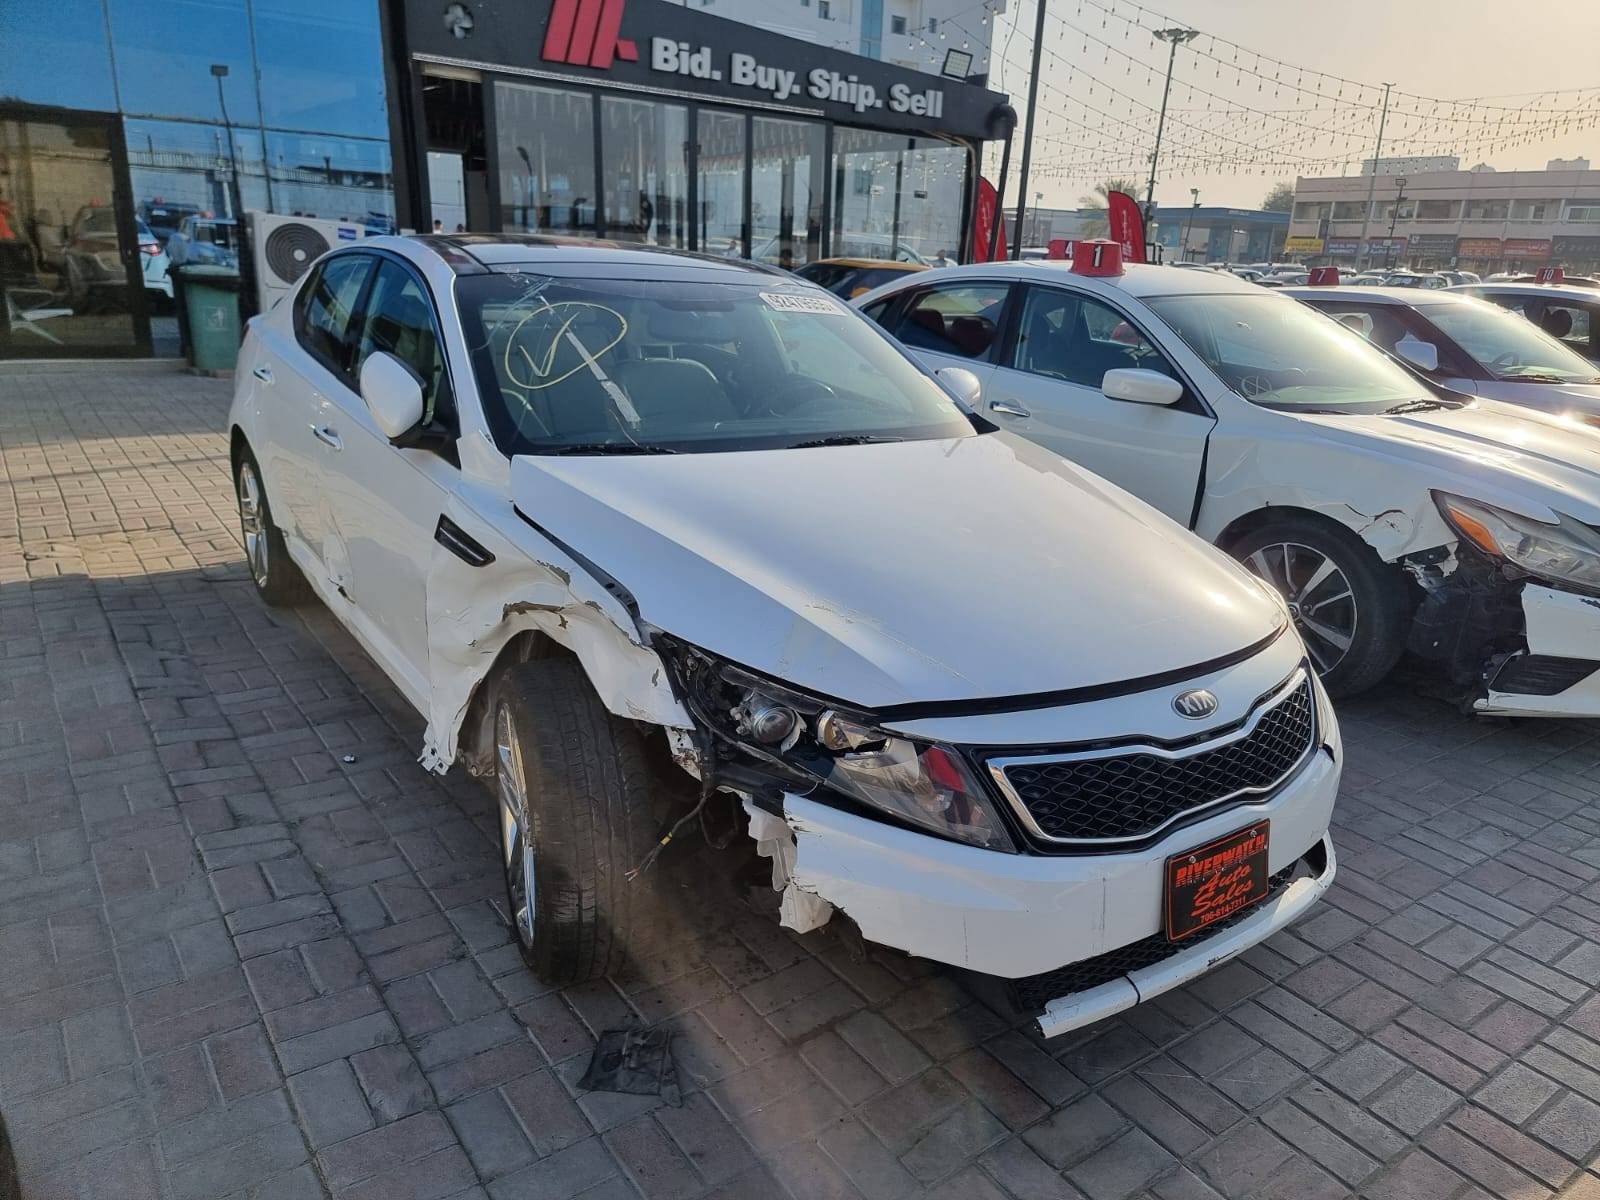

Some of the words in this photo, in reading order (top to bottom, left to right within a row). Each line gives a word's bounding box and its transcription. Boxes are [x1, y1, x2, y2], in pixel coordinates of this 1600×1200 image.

[652, 36, 722, 81] Bid.
[731, 52, 800, 100] Buy.
[808, 68, 883, 113] Ship.
[889, 83, 943, 118] Sell
[1065, 240, 1073, 259] 4
[1094, 245, 1102, 268] 1
[1318, 268, 1326, 282] 7
[1542, 268, 1555, 281] 10
[1178, 694, 1214, 714] KIA
[1193, 864, 1252, 901] Auto
[1191, 880, 1254, 917] Sales
